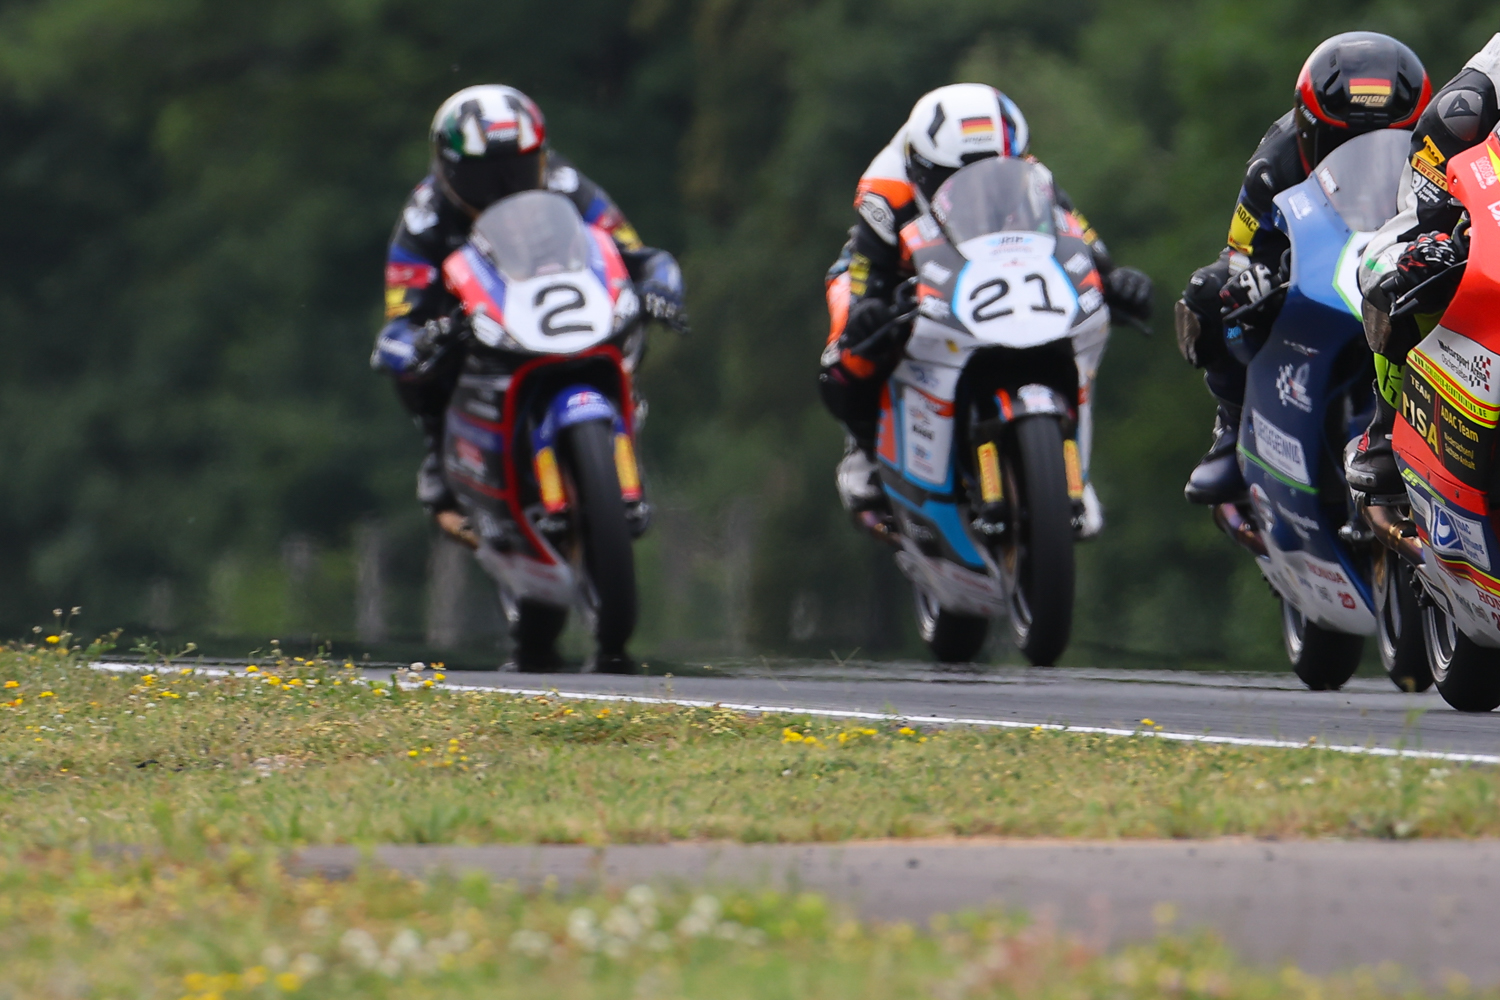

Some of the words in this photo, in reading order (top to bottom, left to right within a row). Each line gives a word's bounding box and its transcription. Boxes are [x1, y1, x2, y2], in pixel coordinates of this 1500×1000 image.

[1350, 95, 1388, 107] NOLAN
[1415, 157, 1446, 188] PIRELLI
[1236, 205, 1258, 232] ADAC
[533, 282, 594, 337] 2
[968, 273, 1066, 324] 21
[1437, 339, 1470, 370] Motorsport
[1470, 362, 1487, 382] Arena
[1410, 375, 1432, 403] TEAM
[1441, 405, 1458, 429] ADAC
[1457, 420, 1479, 442] Team
